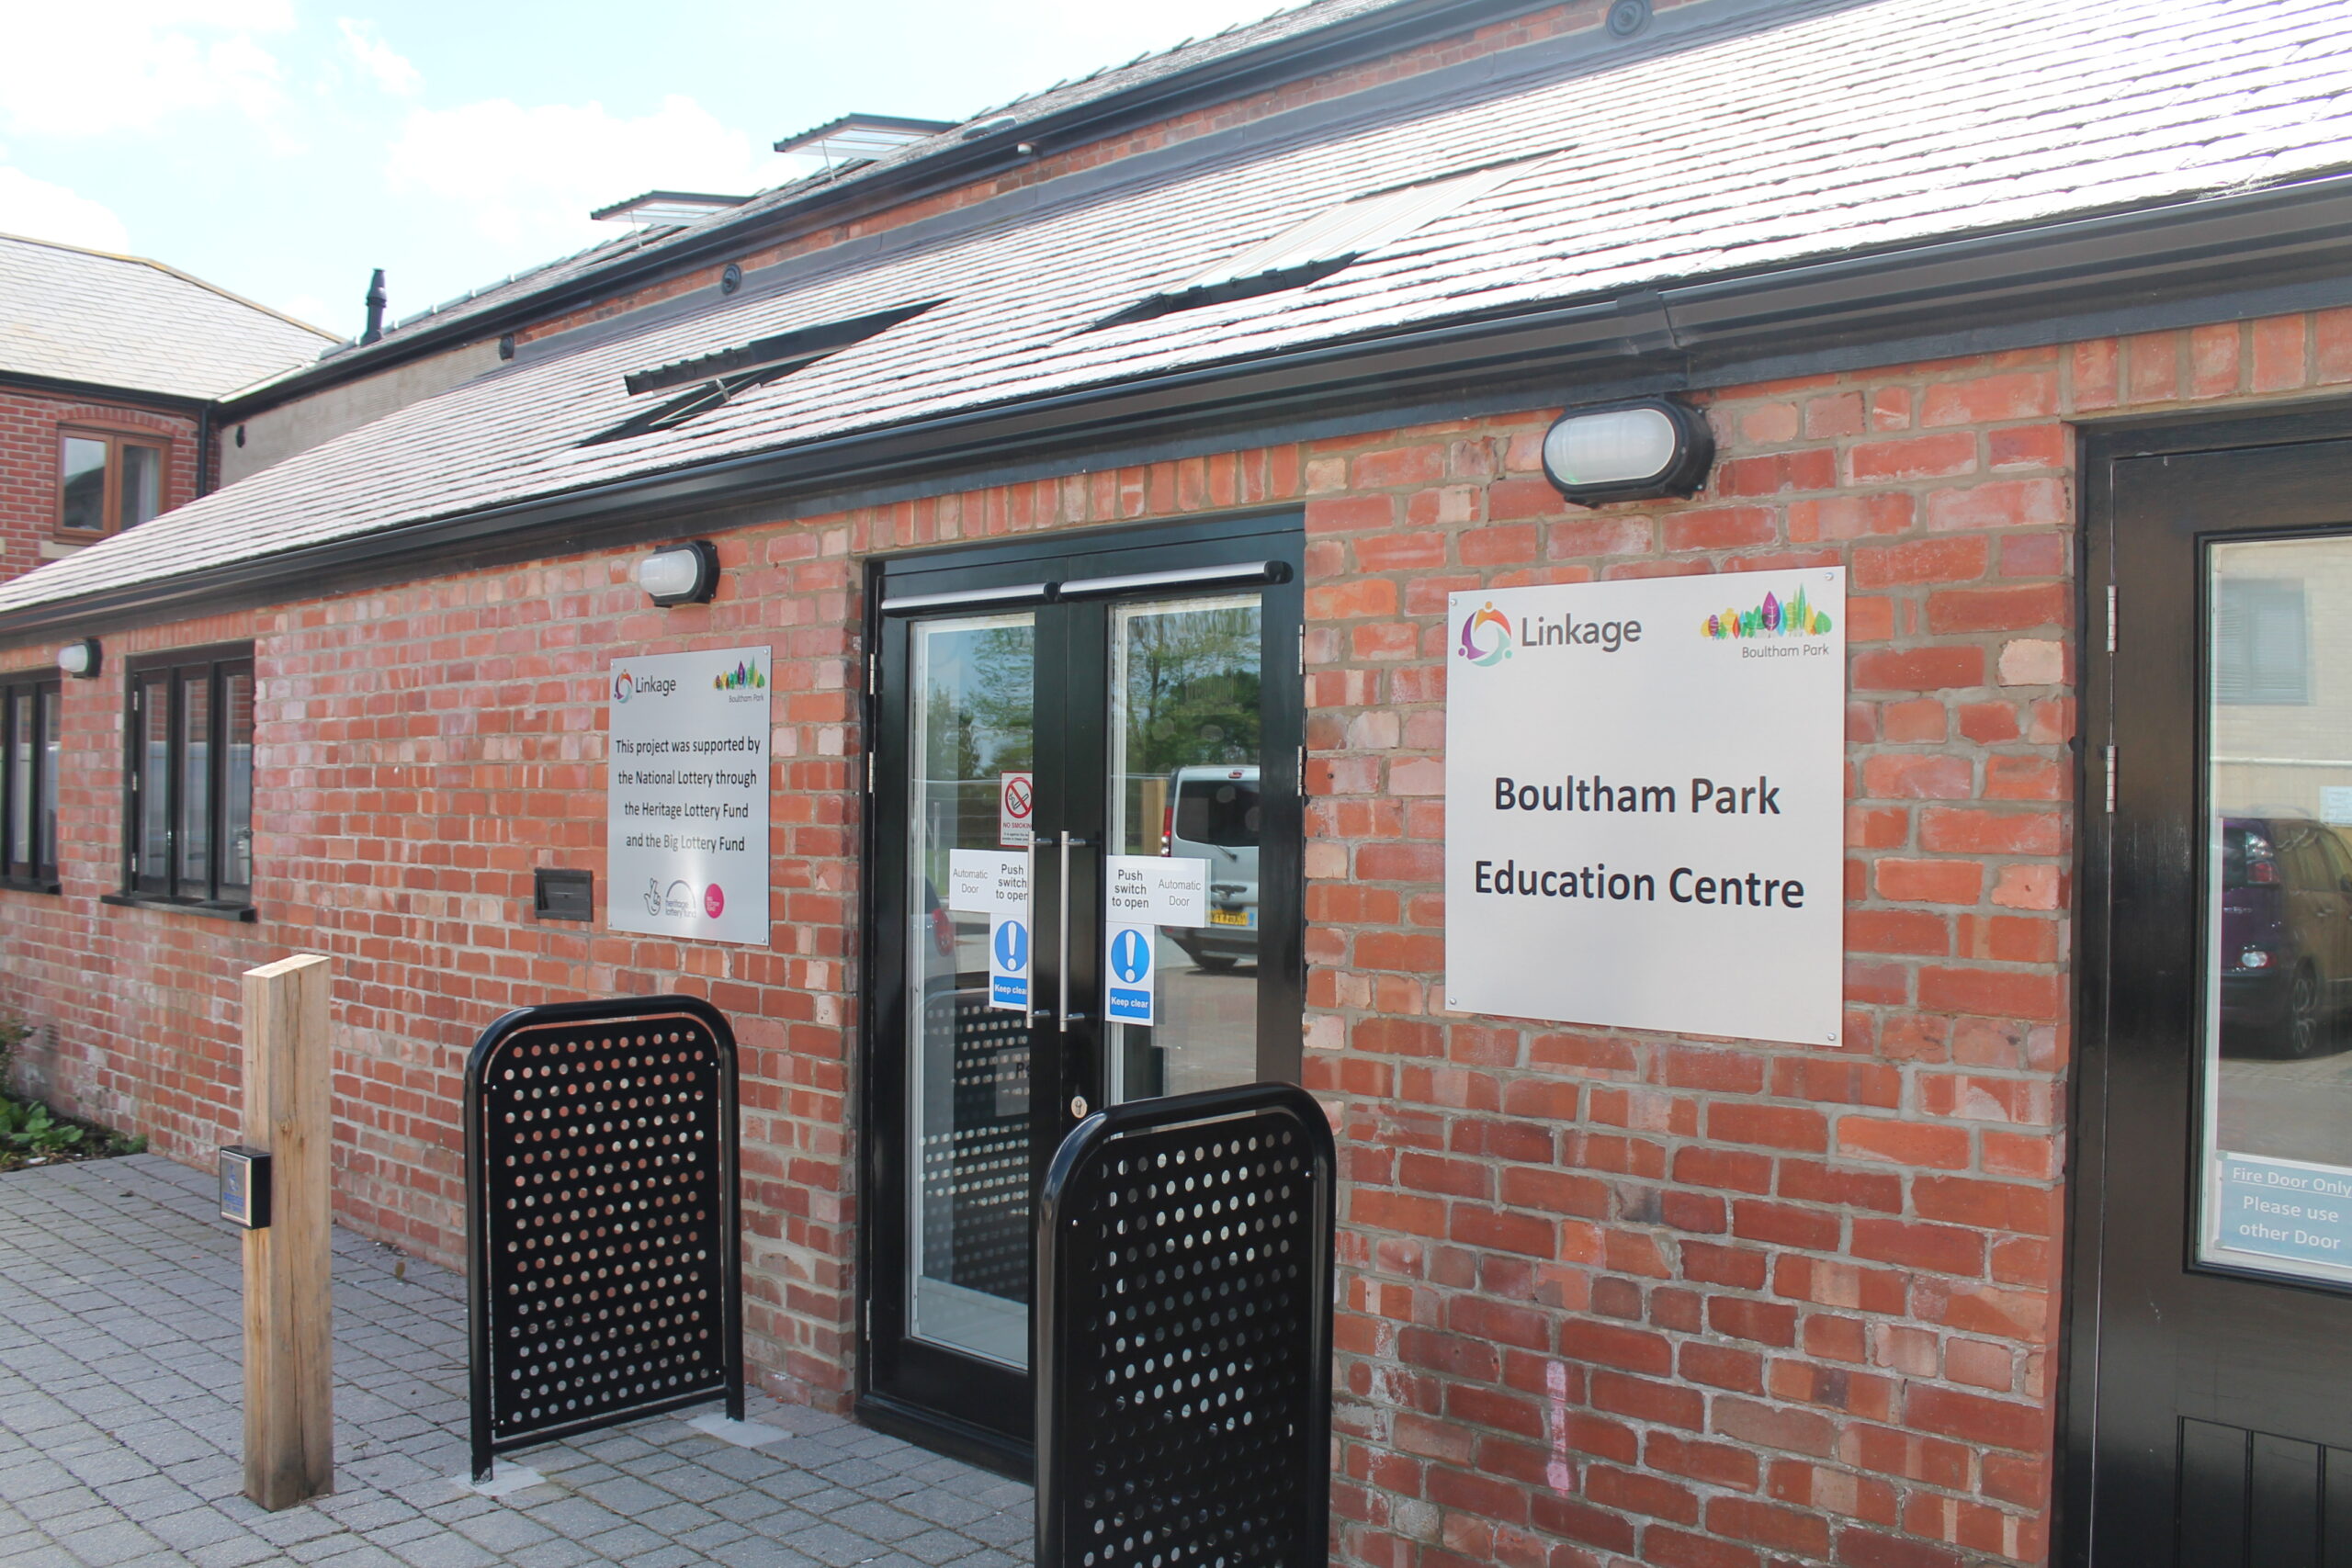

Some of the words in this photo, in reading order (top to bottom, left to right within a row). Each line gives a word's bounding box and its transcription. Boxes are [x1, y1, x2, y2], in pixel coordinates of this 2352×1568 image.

[1521, 613, 1643, 653] Linkage
[1742, 647, 1800, 659] Boultham
[1803, 644, 1830, 657] Park
[636, 675, 677, 697] Linkage
[616, 739, 634, 753] This
[636, 739, 669, 756] project
[672, 741, 690, 752] was
[693, 736, 744, 755] supported
[748, 736, 761, 754] by
[618, 770, 633, 784] the
[636, 770, 675, 784] National
[678, 771, 713, 788] Lottery
[716, 769, 757, 788] through
[1495, 775, 1676, 813] Boultham
[1691, 776, 1781, 815] Park
[625, 801, 639, 816] the
[642, 801, 682, 820] Heritage
[684, 803, 720, 821] Lottery
[723, 803, 749, 818] Fund
[626, 833, 643, 847] and
[646, 833, 661, 848] the
[663, 834, 678, 852] Big
[681, 834, 717, 854] Lottery
[719, 836, 745, 852] Fund
[953, 868, 989, 880] Automatic
[1001, 863, 1023, 875] Push
[1118, 869, 1143, 882] Push
[961, 884, 979, 894] Door
[998, 876, 1027, 888] switch
[1159, 878, 1202, 891] Automatic
[1476, 860, 1655, 902] Education
[1669, 867, 1804, 909] Centre
[996, 890, 1005, 899] to
[1114, 884, 1147, 896] switch
[1112, 897, 1122, 908] to
[1125, 899, 1149, 909] open
[1169, 895, 1190, 908] Door
[994, 983, 1012, 994] Keep
[1111, 996, 1129, 1008] Keep
[1130, 998, 1148, 1009] clear
[2233, 1167, 2262, 1182] Fire
[2267, 1171, 2308, 1189] Door
[2313, 1178, 2352, 1198] Only
[2243, 1195, 2301, 1217] Please
[2307, 1208, 2338, 1223] use
[2239, 1224, 2289, 1241] other
[2295, 1230, 2341, 1249] Door
